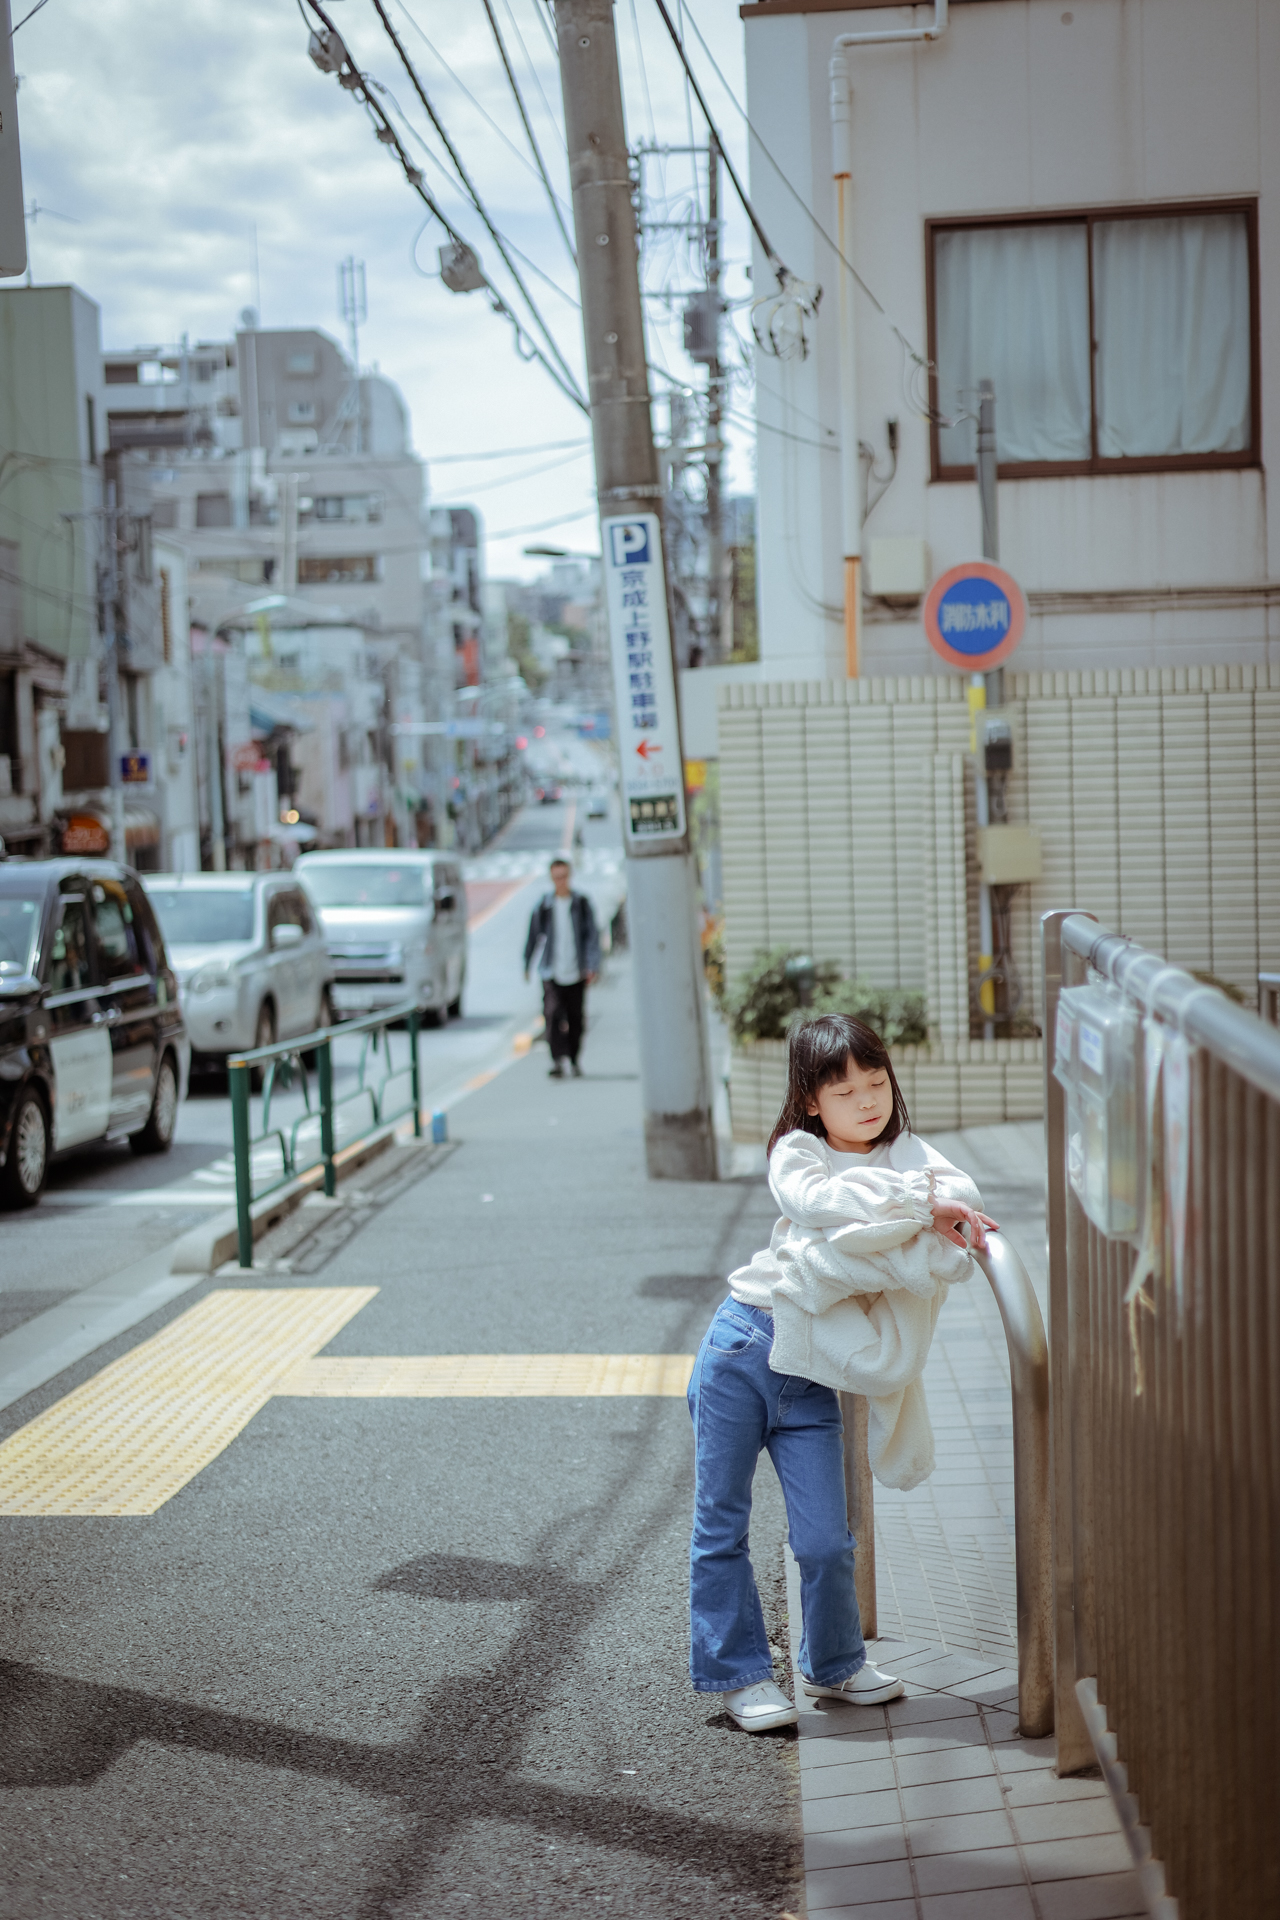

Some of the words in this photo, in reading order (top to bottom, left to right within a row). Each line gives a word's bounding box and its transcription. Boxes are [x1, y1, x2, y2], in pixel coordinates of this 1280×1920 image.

[612, 524, 647, 565] P
[621, 571, 657, 729] 京成上野駅駐車場
